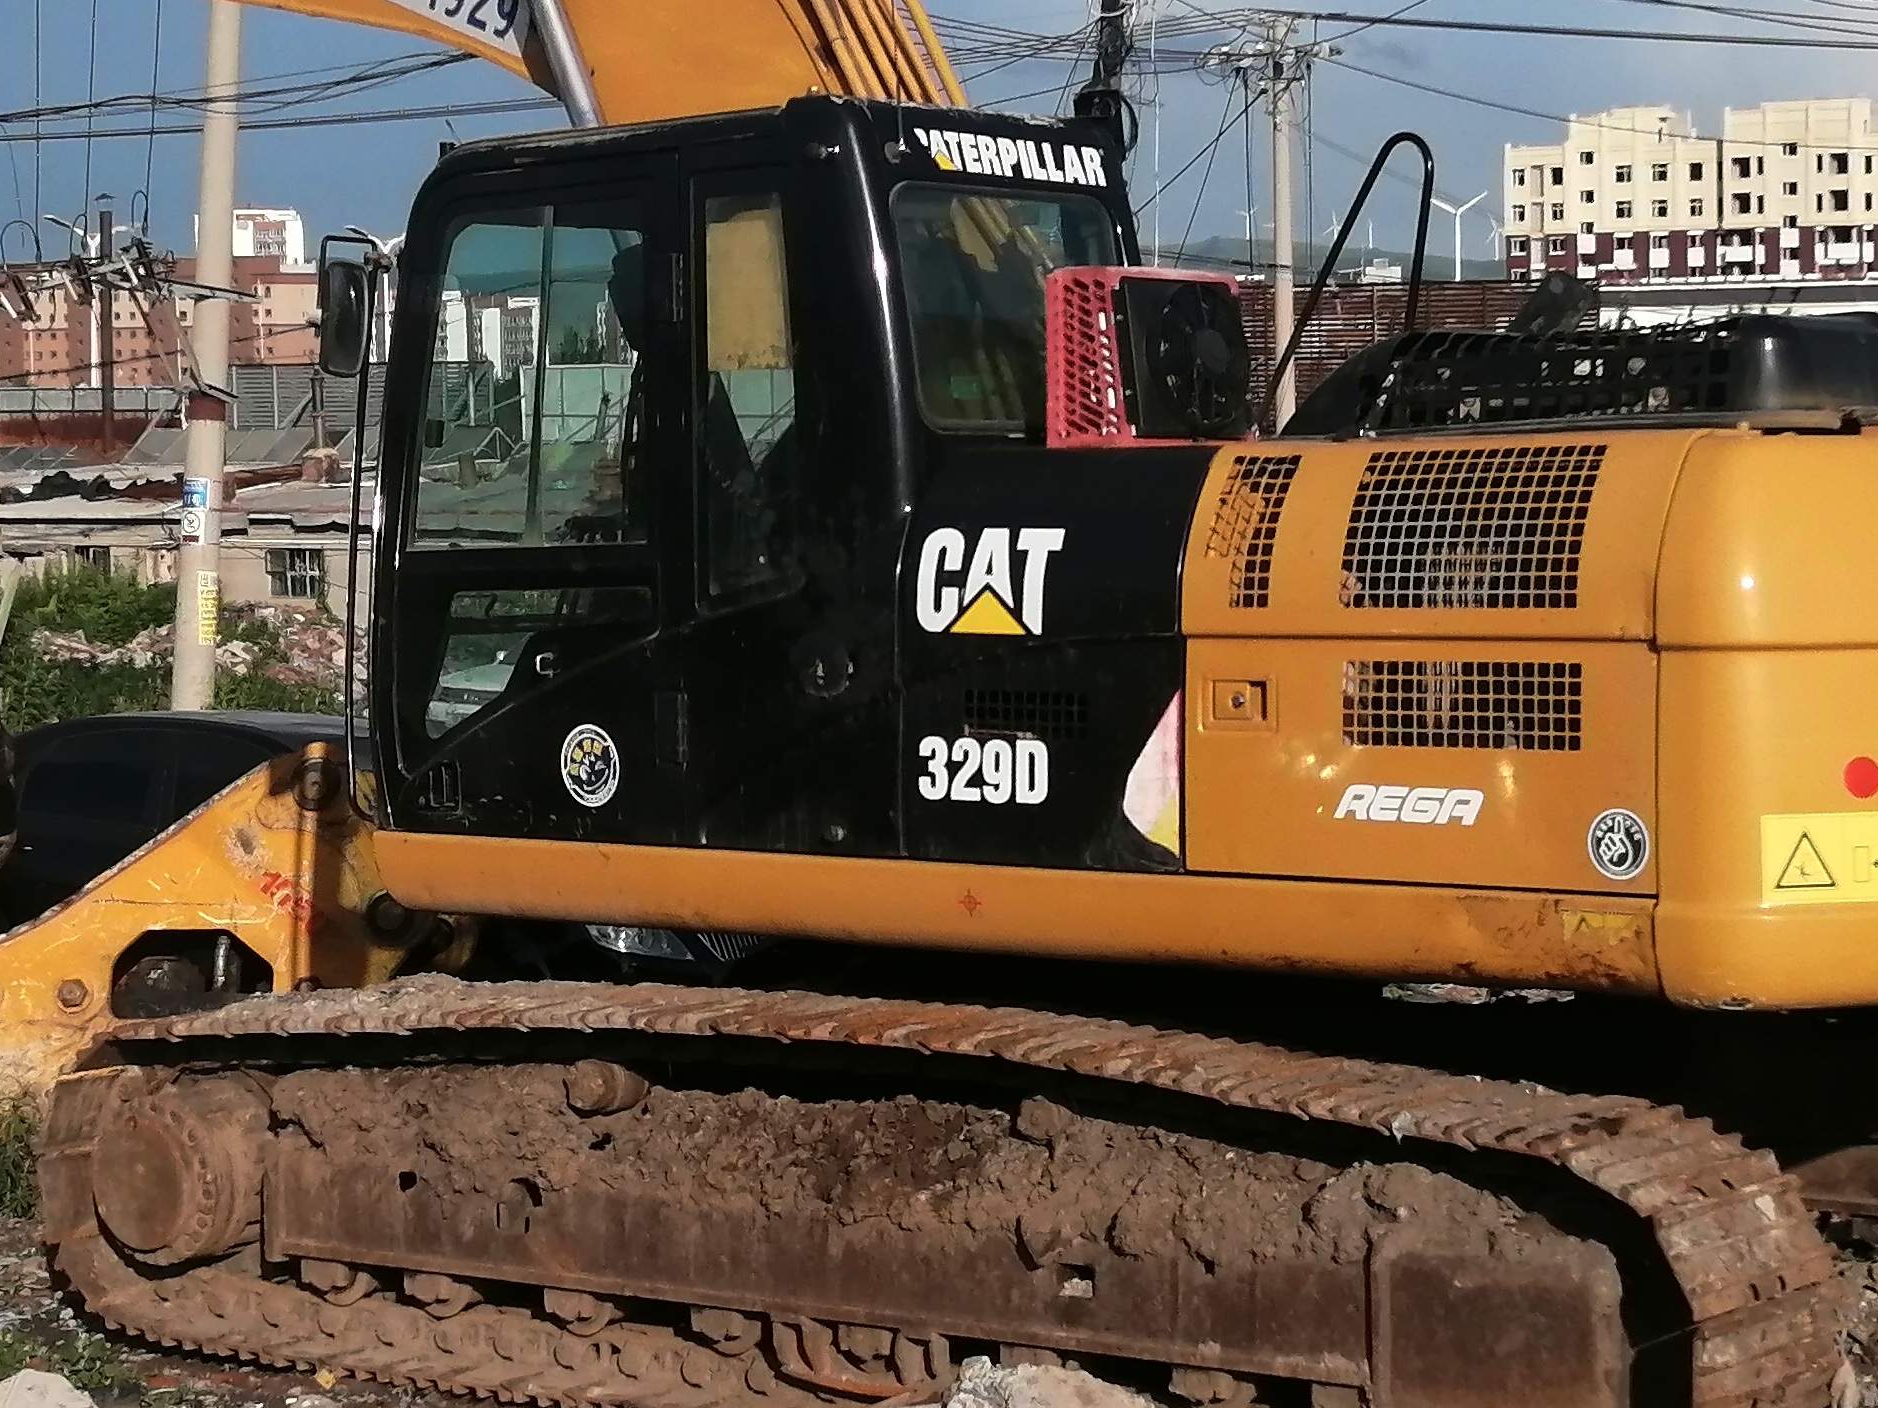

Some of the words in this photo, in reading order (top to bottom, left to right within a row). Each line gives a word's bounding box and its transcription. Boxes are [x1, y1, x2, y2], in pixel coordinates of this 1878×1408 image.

[916, 527, 1066, 636] CAT
[918, 735, 1049, 805] 329D
[1334, 784, 1484, 826] REGA
